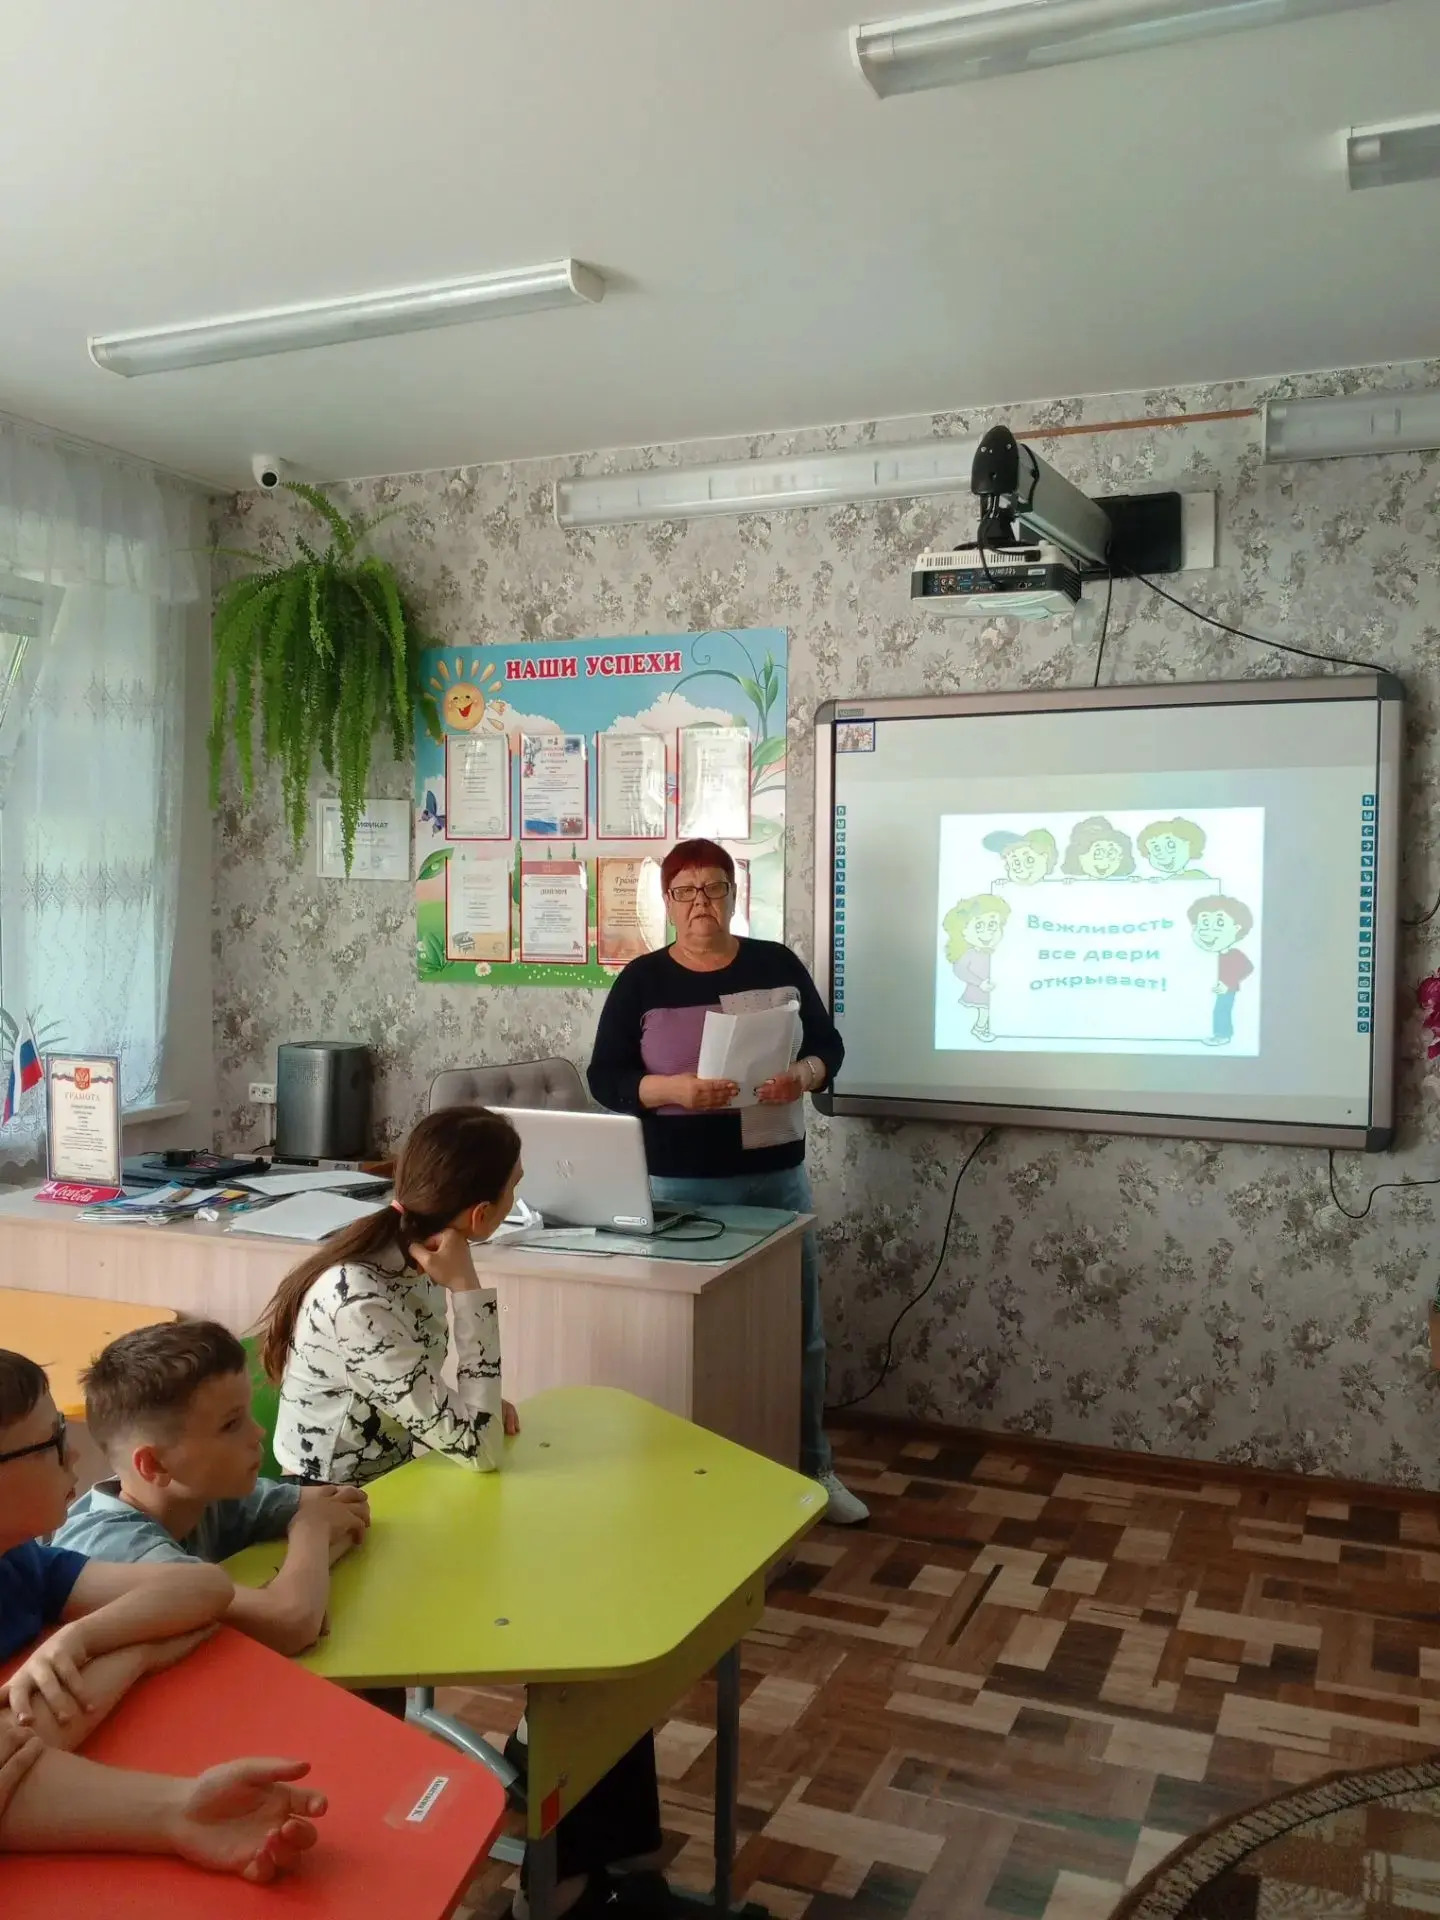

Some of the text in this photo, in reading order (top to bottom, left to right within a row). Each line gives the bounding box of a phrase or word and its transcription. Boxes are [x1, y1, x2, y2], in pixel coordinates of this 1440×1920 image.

[505, 651, 682, 680] НАШИ УСПЕХИ
[1027, 914, 1175, 935] Вежливость
[1038, 949, 1161, 962] все двери
[1029, 975, 1168, 992] открывает!
